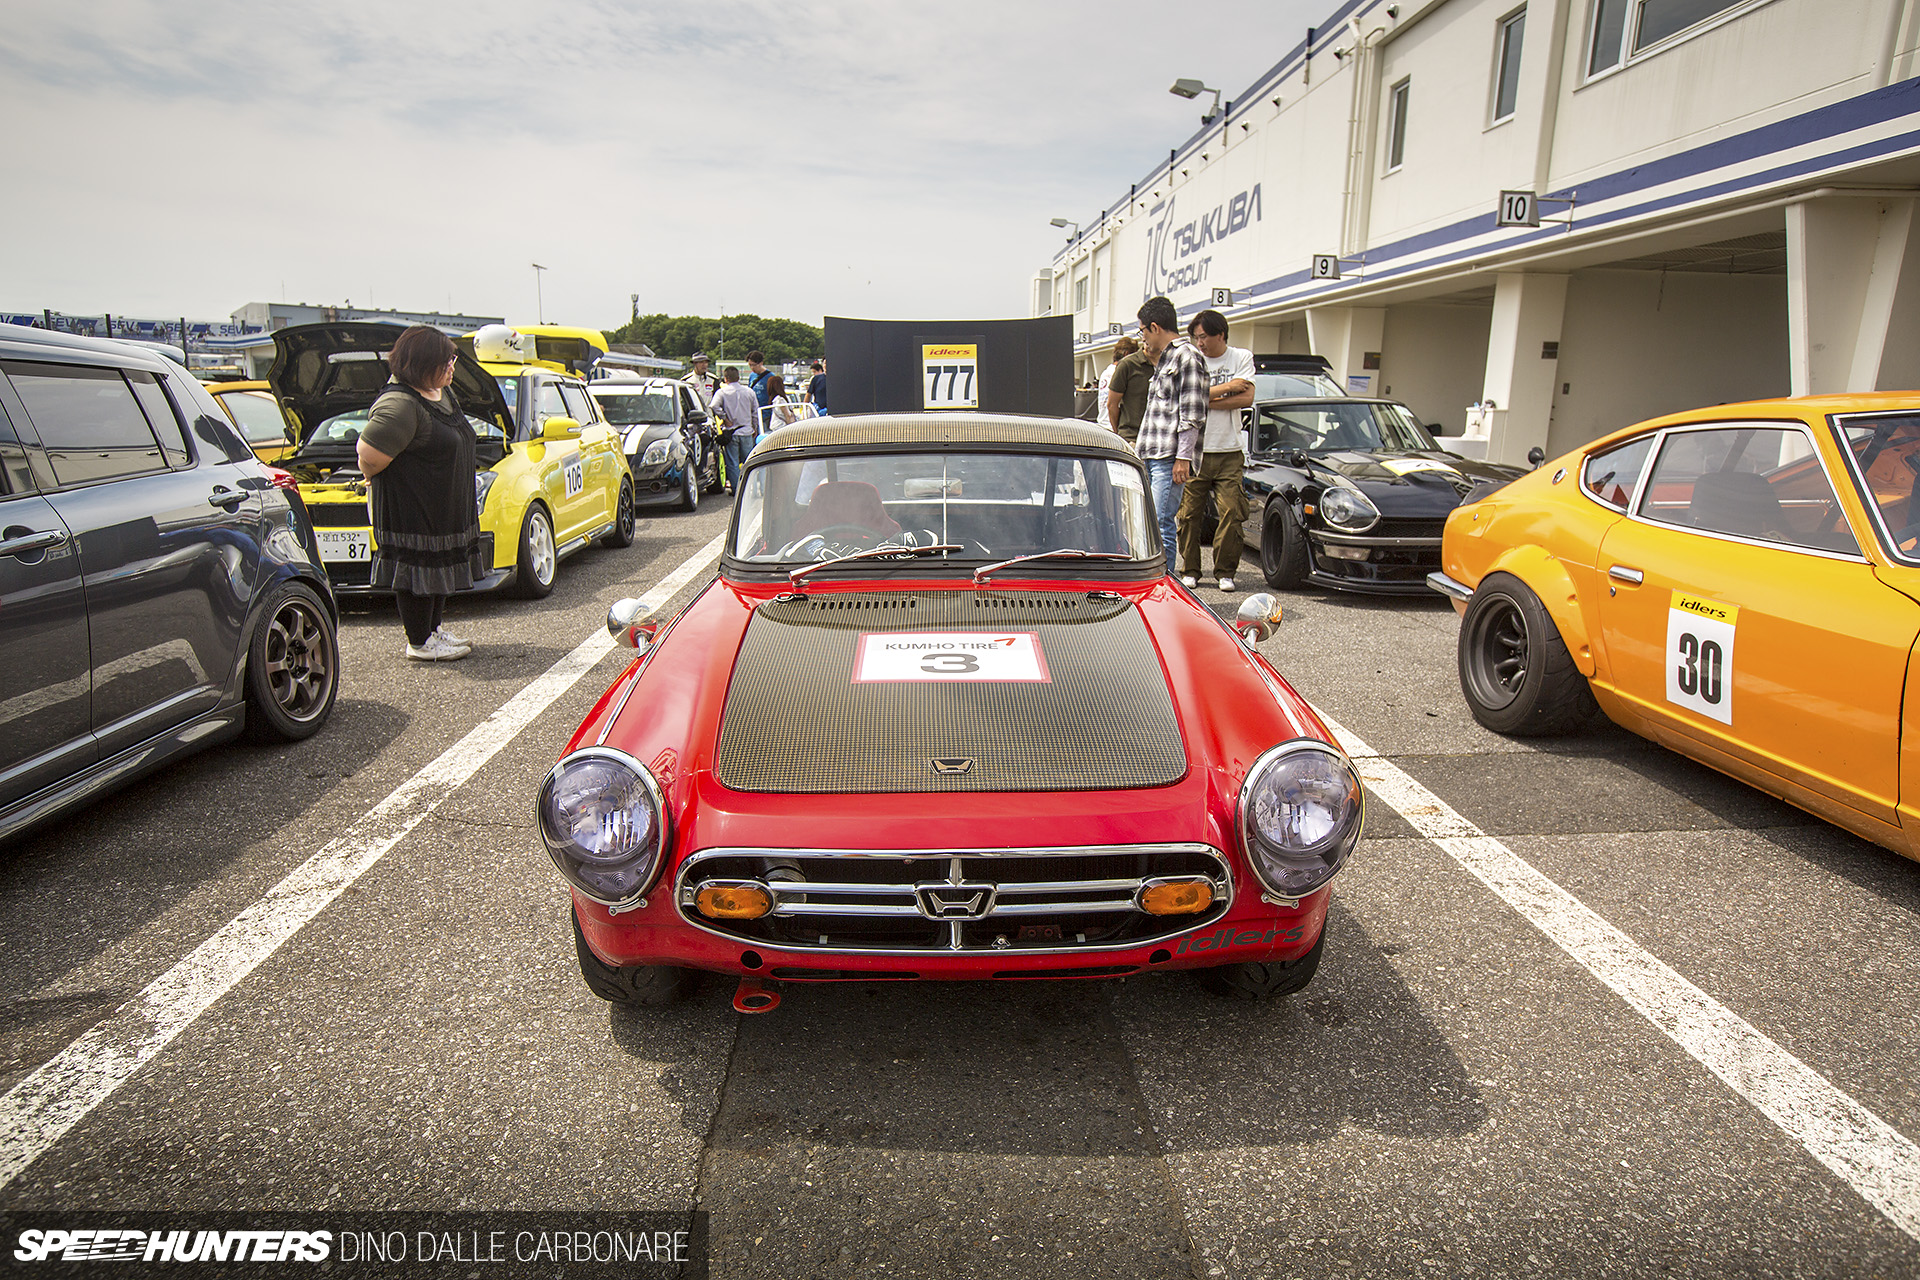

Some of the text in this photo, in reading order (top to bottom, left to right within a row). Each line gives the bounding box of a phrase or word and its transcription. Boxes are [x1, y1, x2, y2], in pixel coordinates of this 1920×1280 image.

[1507, 196, 1526, 221] 10
[1173, 182, 1262, 261] TSUKUBA
[1320, 258, 1329, 275] 9
[1217, 291, 1224, 304] 8
[929, 348, 970, 356] idlers
[926, 365, 975, 401] 777
[567, 464, 582, 494] 106
[341, 532, 357, 542] 532
[1680, 598, 1727, 619] idlers
[885, 642, 999, 650] KUMHO TIRE
[920, 653, 980, 673] 3
[1678, 632, 1722, 705] 30
[1175, 925, 1305, 955] idlers
